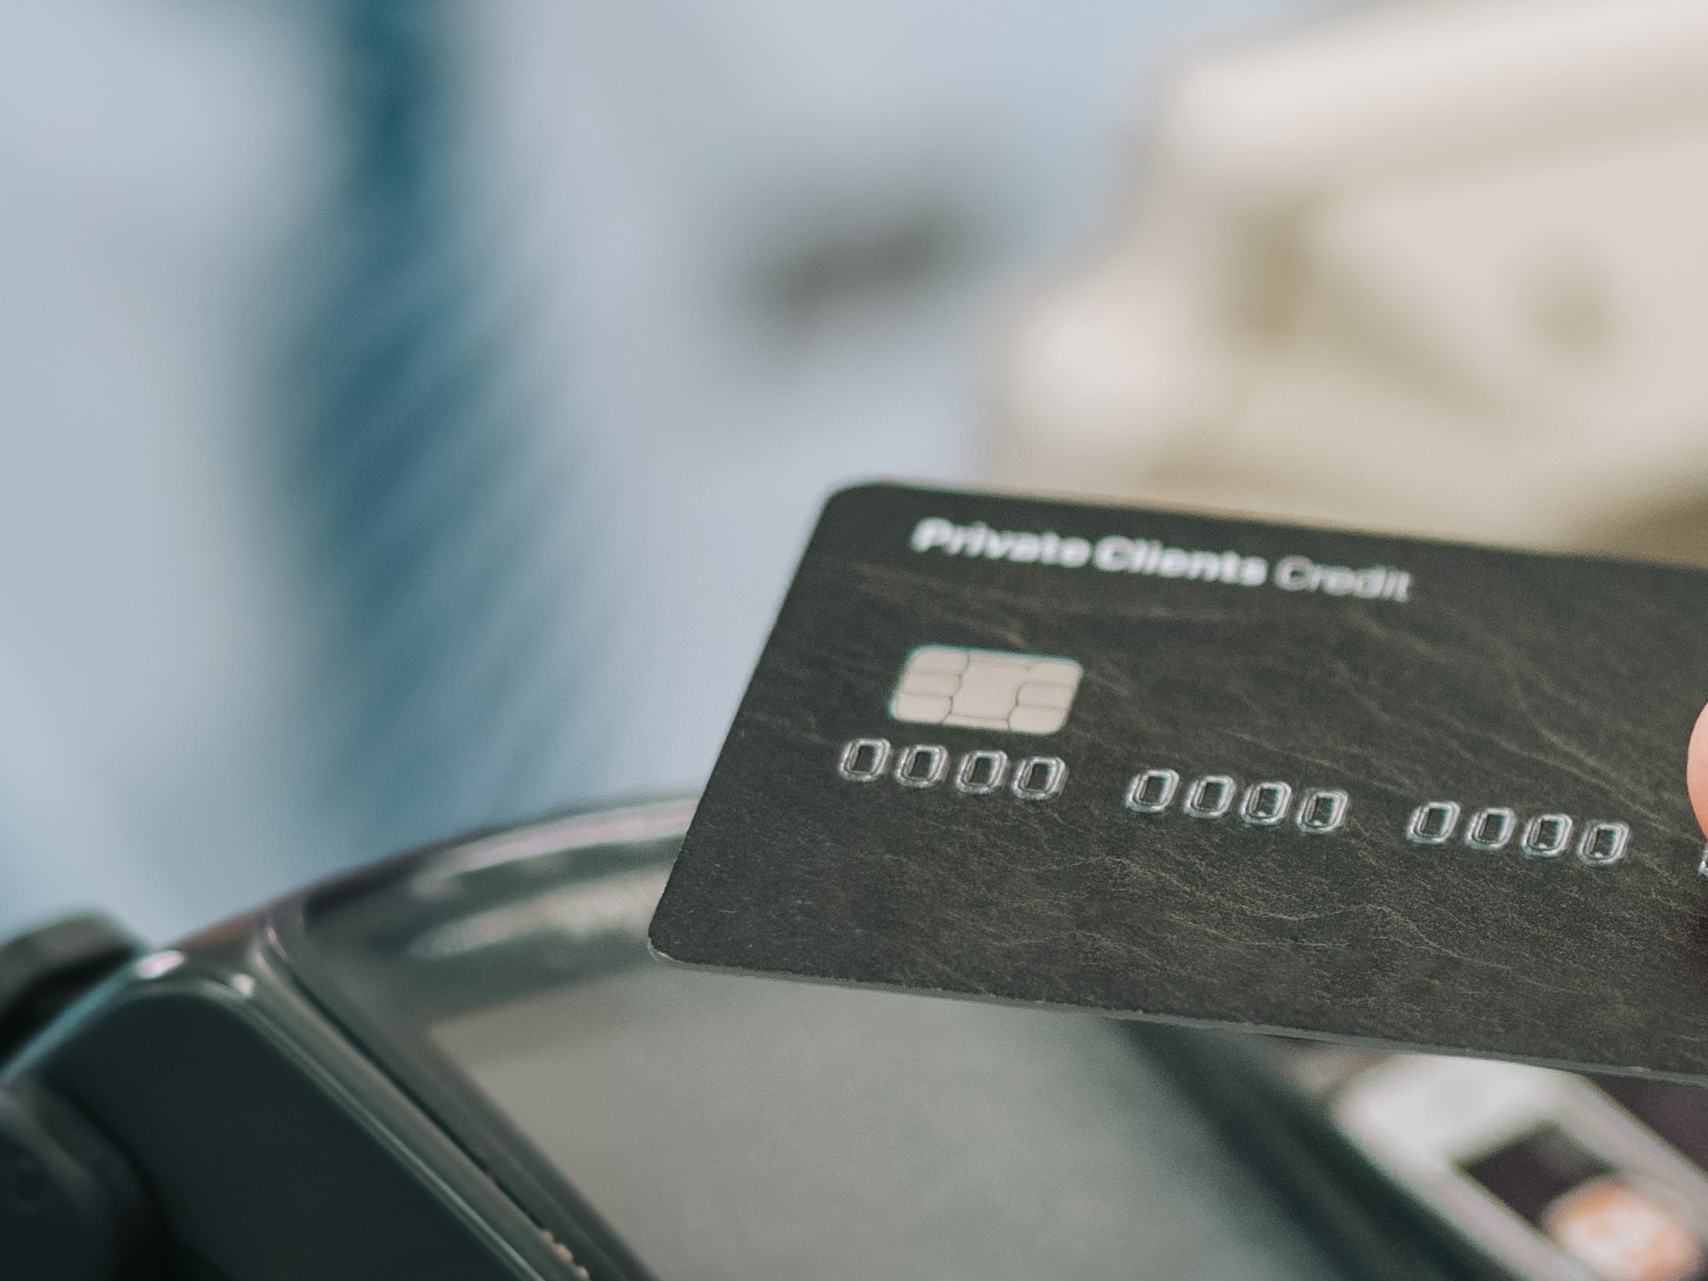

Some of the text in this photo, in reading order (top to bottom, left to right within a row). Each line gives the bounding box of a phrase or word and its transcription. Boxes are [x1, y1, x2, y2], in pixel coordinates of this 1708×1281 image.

[910, 518, 1411, 603] Private Clients Credit
[839, 737, 1068, 801] 0000
[1125, 768, 1351, 836] 0000
[1405, 800, 1631, 866] 0000
